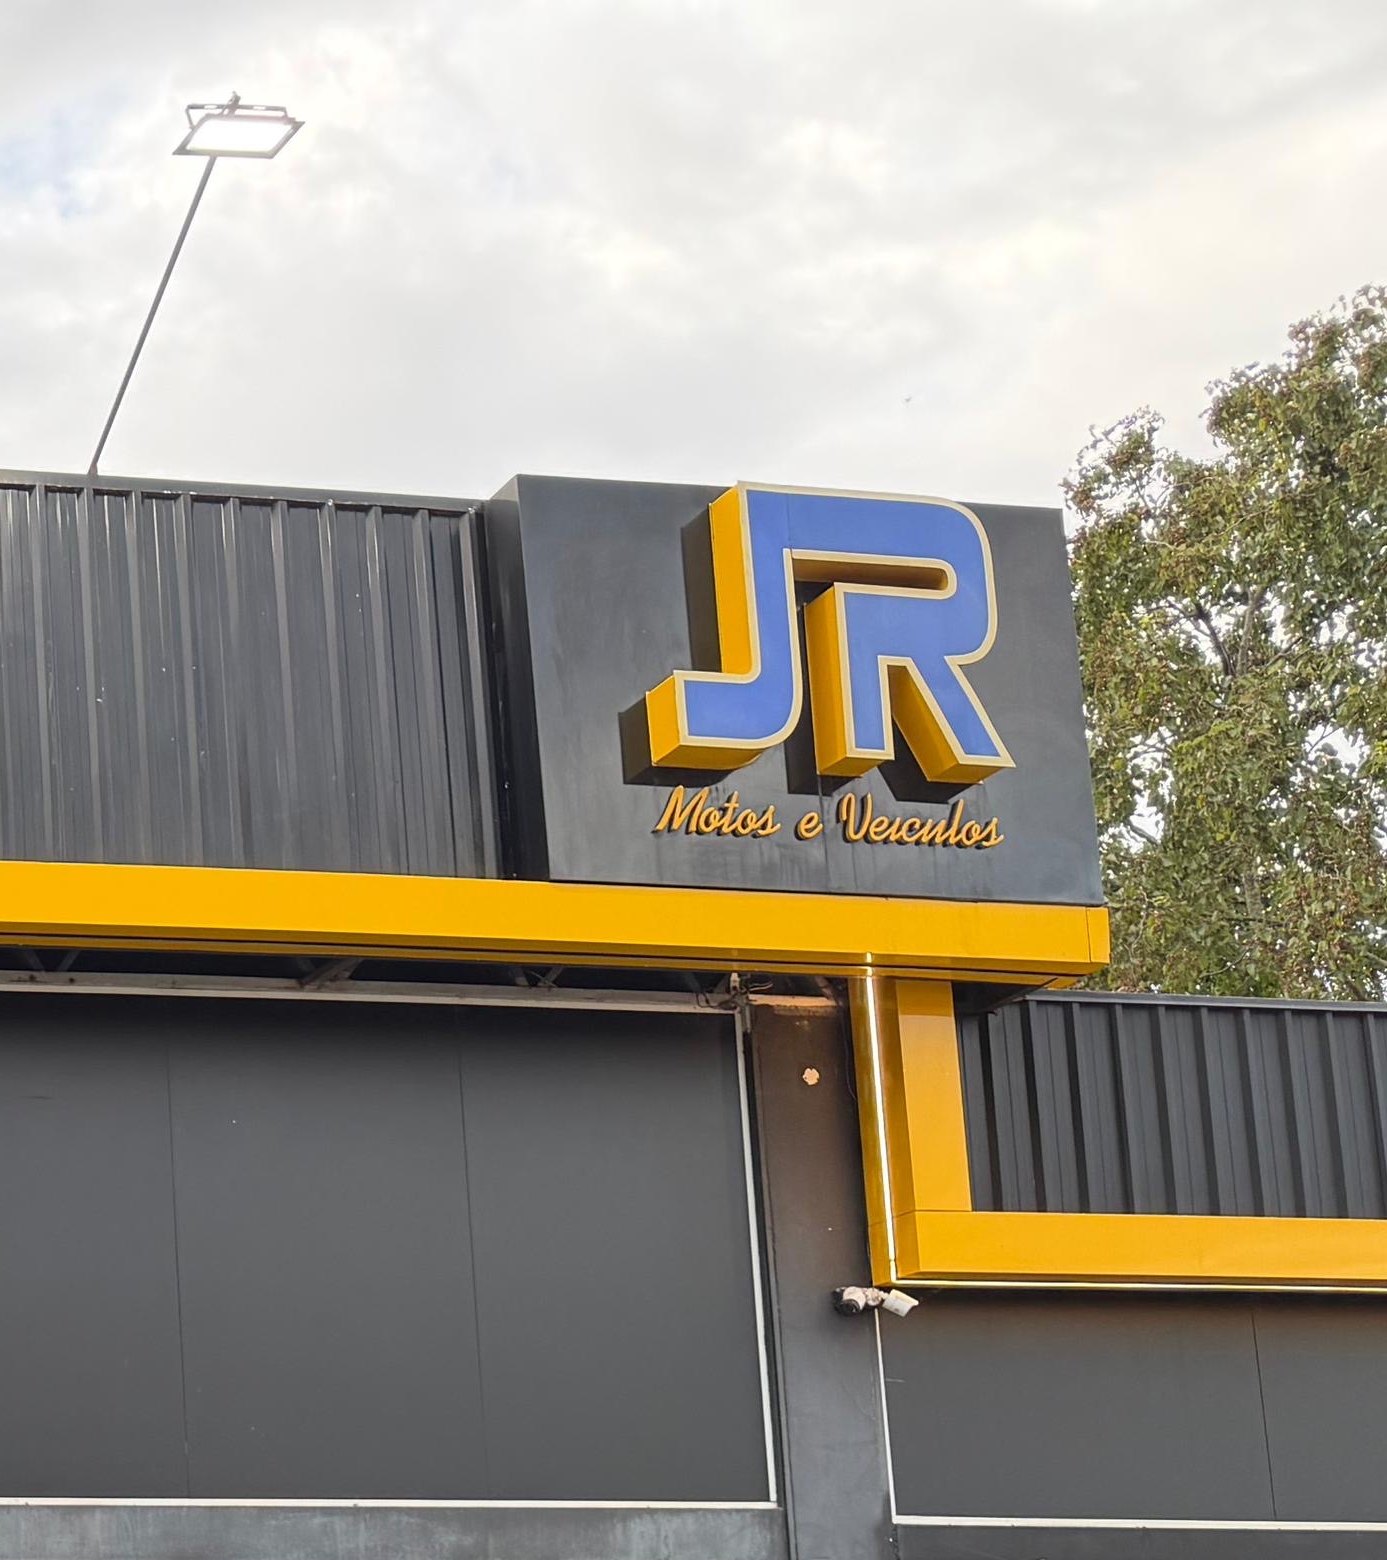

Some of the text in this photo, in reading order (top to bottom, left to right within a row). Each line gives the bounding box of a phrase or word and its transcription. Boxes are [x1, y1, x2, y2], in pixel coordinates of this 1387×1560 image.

[663, 480, 1015, 775] JR
[656, 785, 782, 836] Motos
[800, 811, 824, 840] e
